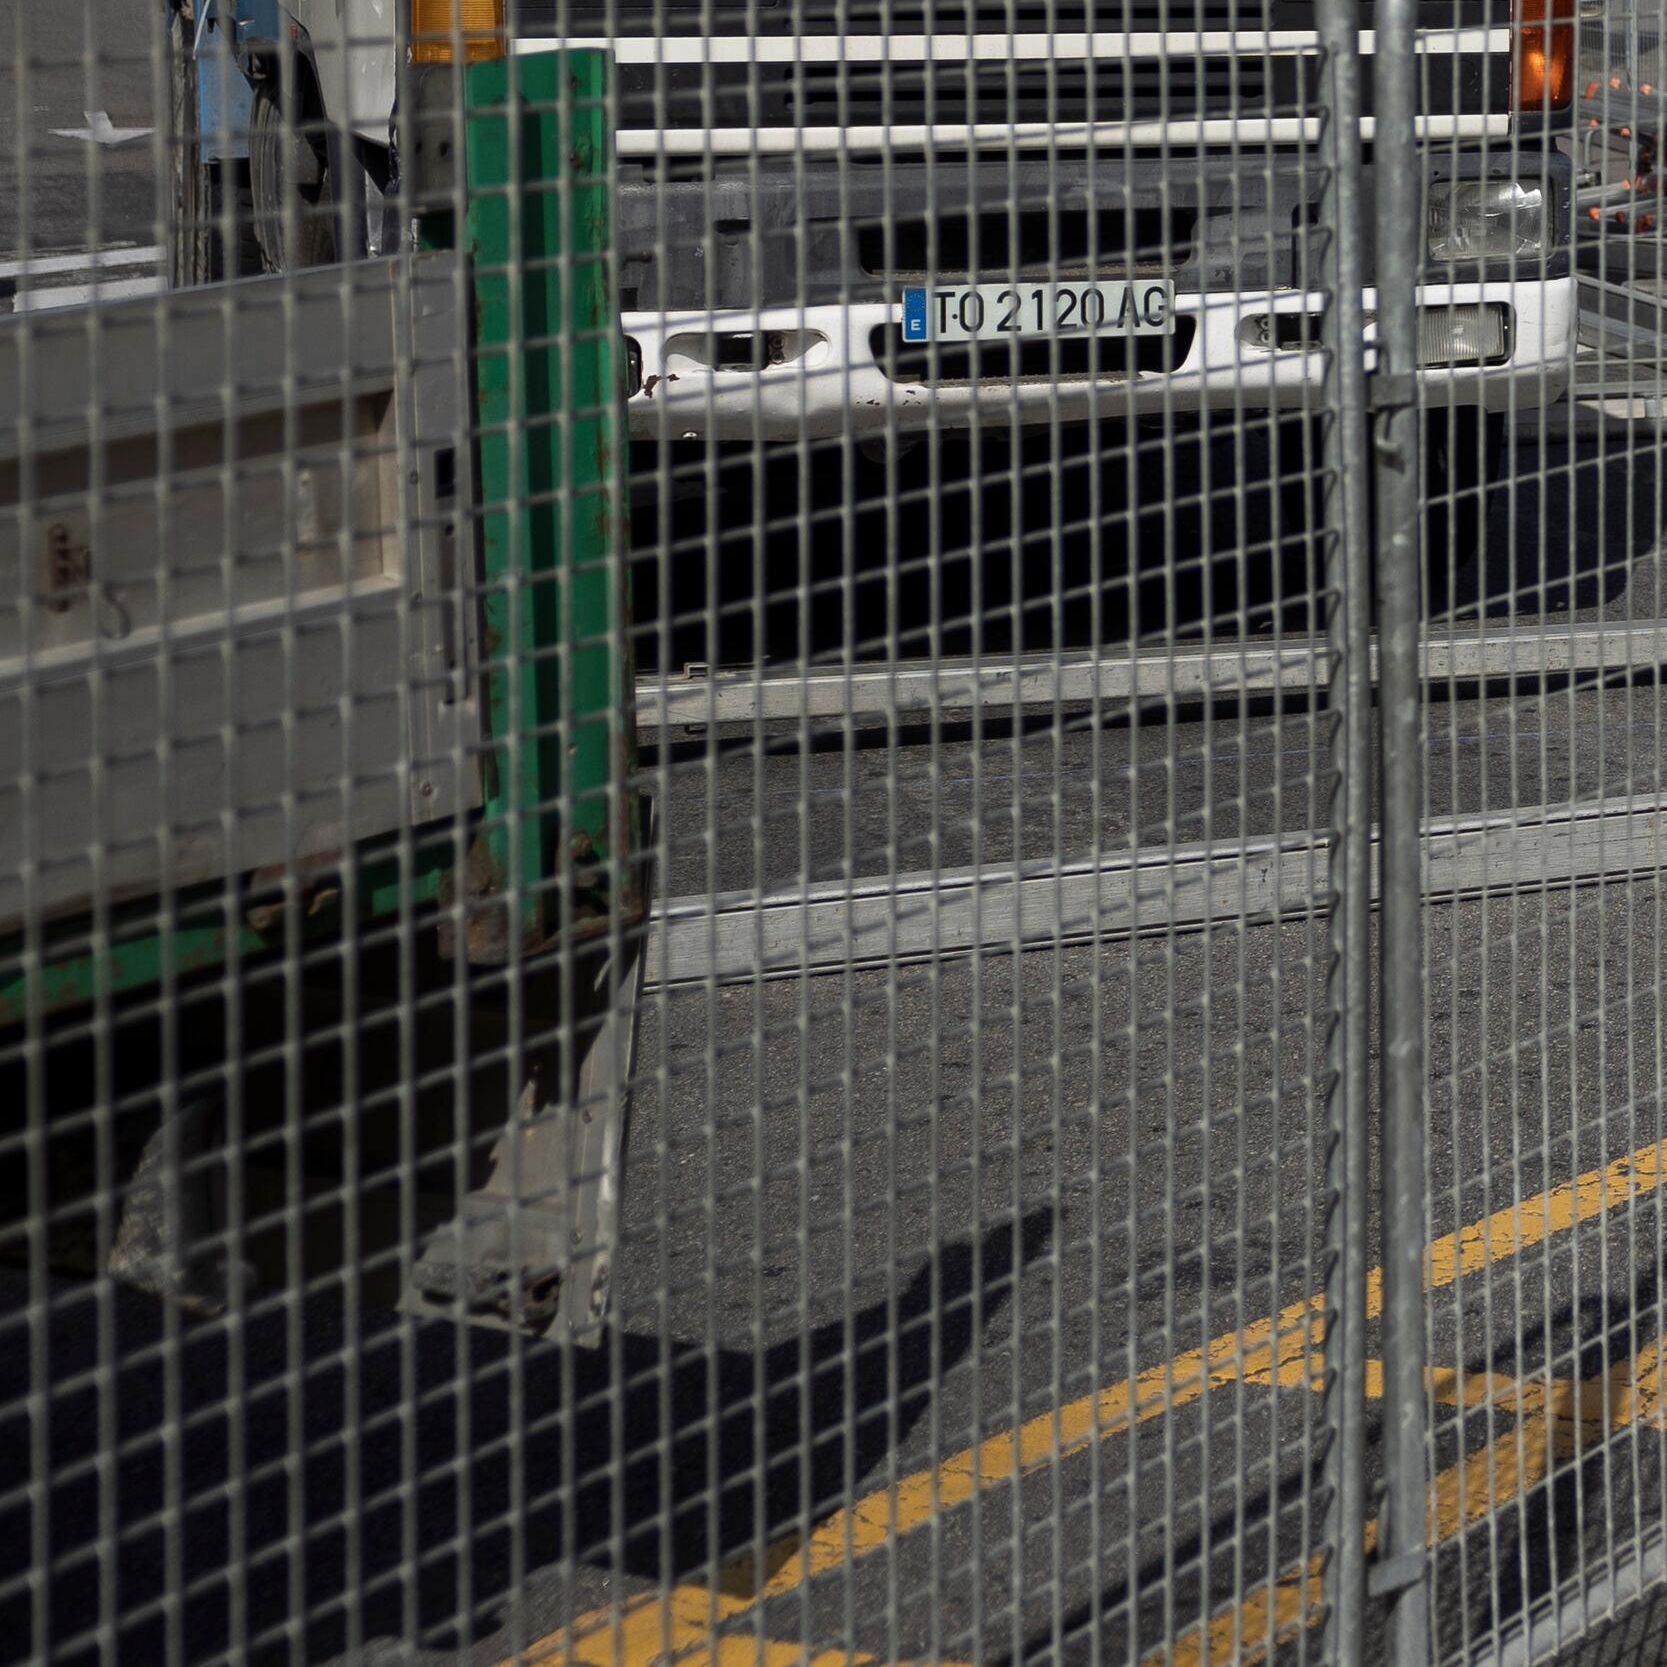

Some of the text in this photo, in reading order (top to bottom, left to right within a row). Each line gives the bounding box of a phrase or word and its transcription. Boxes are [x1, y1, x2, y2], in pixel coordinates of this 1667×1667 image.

[910, 318, 921, 331] E
[996, 287, 1105, 332] 2120
[1116, 285, 1169, 330] AG
